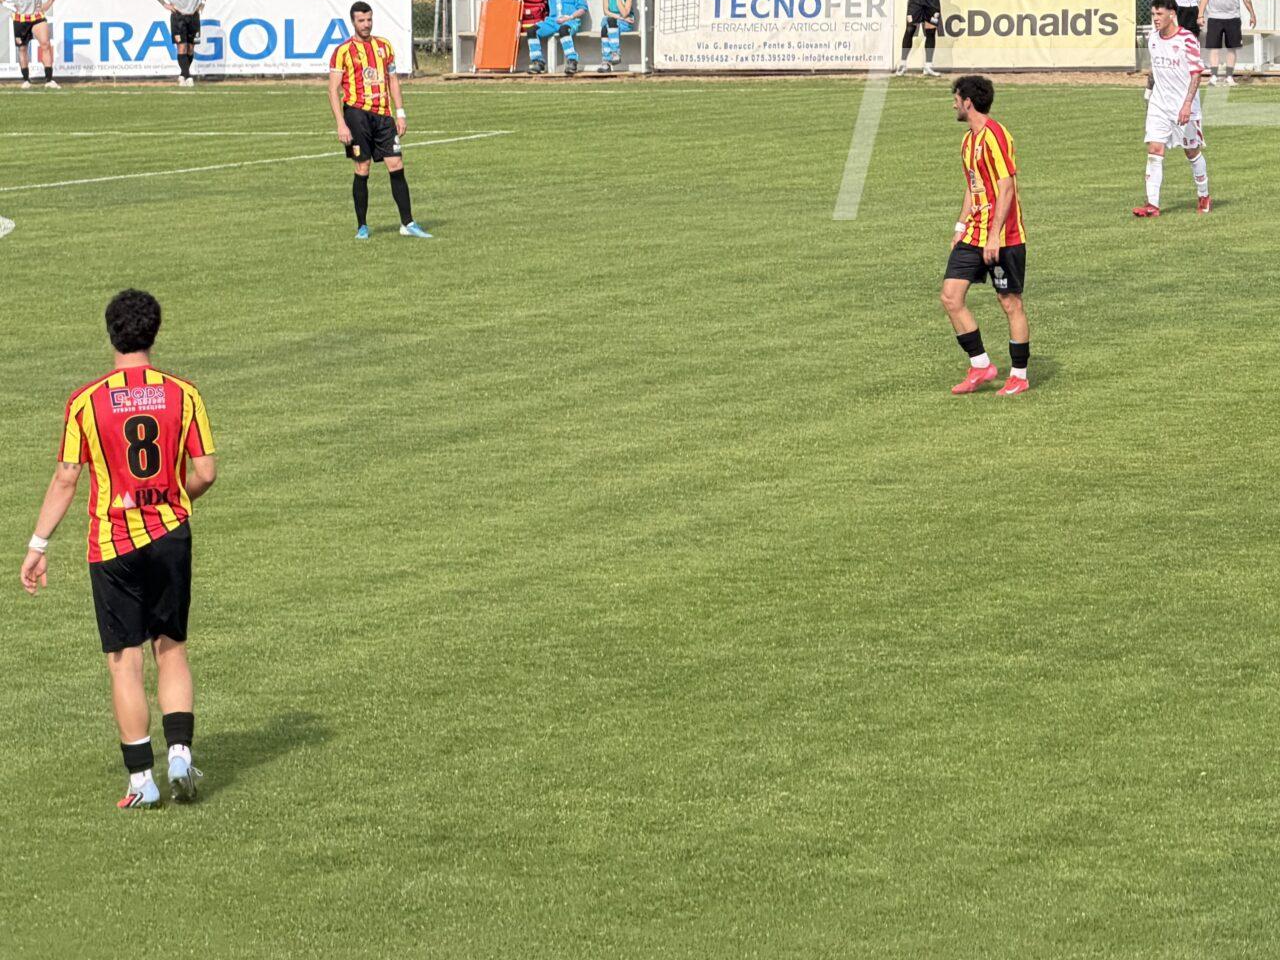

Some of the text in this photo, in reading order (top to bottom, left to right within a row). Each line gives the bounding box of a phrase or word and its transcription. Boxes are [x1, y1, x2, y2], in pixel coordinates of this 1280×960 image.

[711, 23, 779, 33] FERRAMENTA
[789, 22, 837, 32] ARTICOLI
[63, 18, 351, 63] FRAGOLA
[697, 42, 709, 50] Via
[713, 42, 721, 50] G.
[724, 42, 755, 50] Benucci
[797, 41, 831, 49] Giovanni
[834, 41, 851, 50] (PG)
[664, 54, 678, 62] Tel.
[736, 54, 749, 62] Fax
[123, 413, 162, 480] 8
